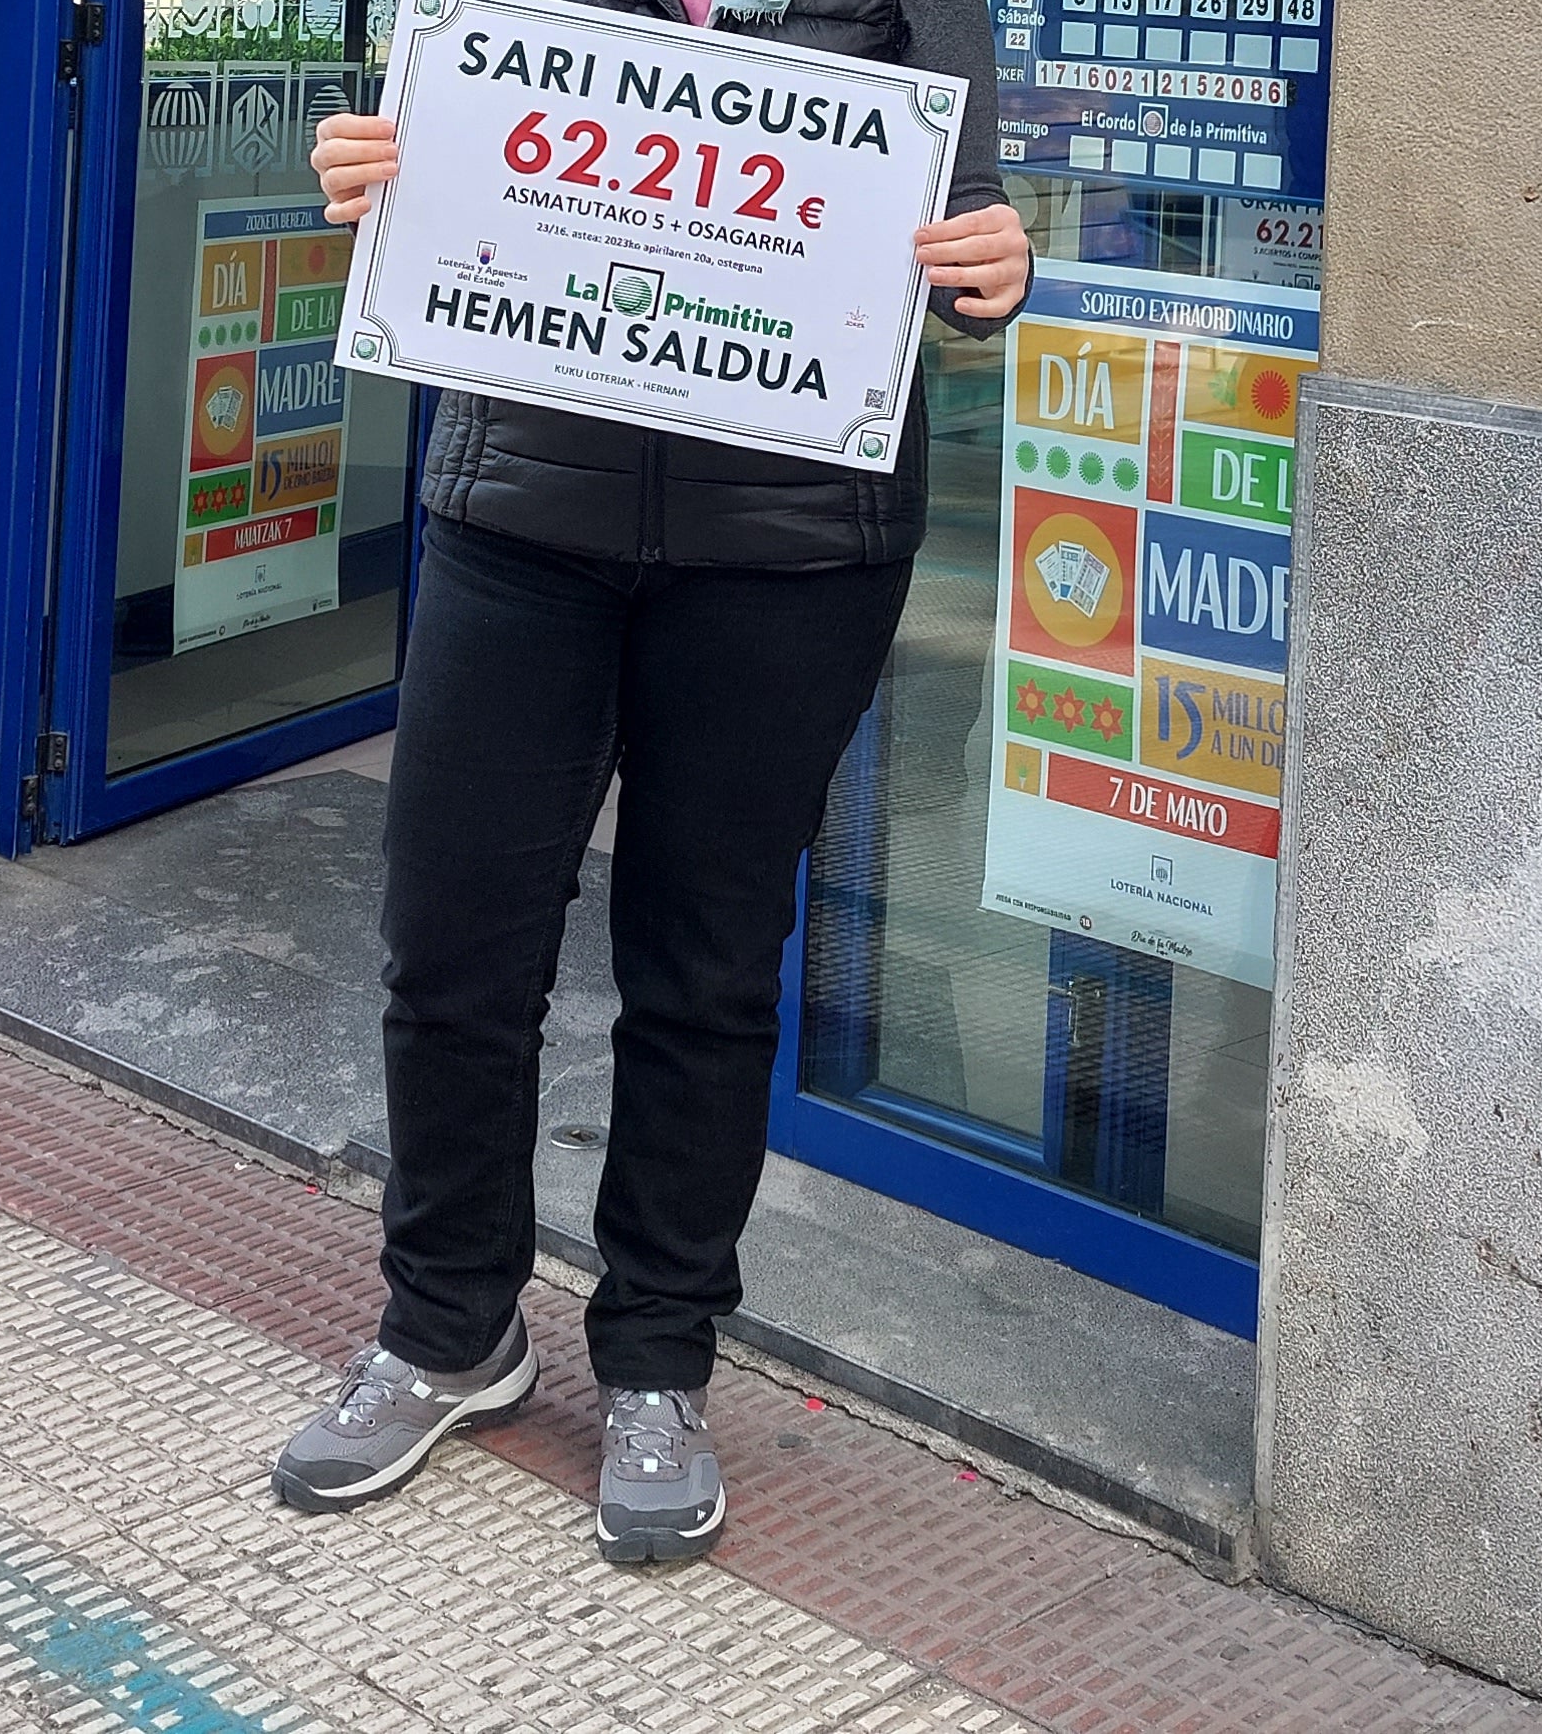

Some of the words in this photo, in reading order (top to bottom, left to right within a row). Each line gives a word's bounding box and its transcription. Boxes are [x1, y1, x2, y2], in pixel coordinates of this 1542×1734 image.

[997, 10, 1046, 26] Sábado
[458, 31, 597, 97] SARI
[615, 63, 890, 154] NAGUSIA
[1082, 111, 1093, 127] El
[1097, 114, 1136, 131] Gordo
[1170, 123, 1186, 138] de
[1189, 125, 1201, 141] la
[1205, 125, 1267, 144] Primitiva
[503, 111, 786, 223] 62.212
[797, 197, 825, 228] €
[503, 186, 647, 226] ASMATUTAKO
[653, 214, 665, 229] 5
[688, 218, 806, 258] OSAGARRIA
[213, 251, 247, 308] DÍA
[457, 272, 471, 281] del
[476, 266, 483, 275] y
[484, 266, 528, 282] Apuestas
[605, 236, 641, 249] 2023ko
[643, 244, 691, 260] apirilaren
[718, 258, 763, 274] osteguna
[291, 298, 315, 331] DE
[319, 296, 335, 327] LA
[565, 274, 599, 302] La
[664, 293, 794, 339] Primitiva
[1080, 291, 1145, 320] SORTEO
[1149, 299, 1293, 340] EXTRAORDINARIO
[426, 284, 607, 356] HEMEN
[623, 324, 828, 399] SALDUA
[260, 364, 341, 417] MADRE
[554, 365, 584, 378] KUKU
[586, 369, 635, 388] LOTERIAK
[643, 381, 689, 398] HERNANI
[1038, 342, 1115, 430] DÍA
[260, 450, 283, 501] 15
[1212, 448, 1266, 508] DE
[234, 520, 281, 550] MAIATZAK
[284, 518, 292, 538] 7
[1156, 676, 1206, 759] 15
[1211, 730, 1222, 755] A
[1230, 734, 1254, 762] UN
[1109, 777, 1122, 807] 7
[1130, 783, 1161, 820] DE
[1166, 792, 1227, 837] MAYO
[1111, 878, 1153, 900] LOTERÍA
[1159, 892, 1213, 915] NACIONAL
